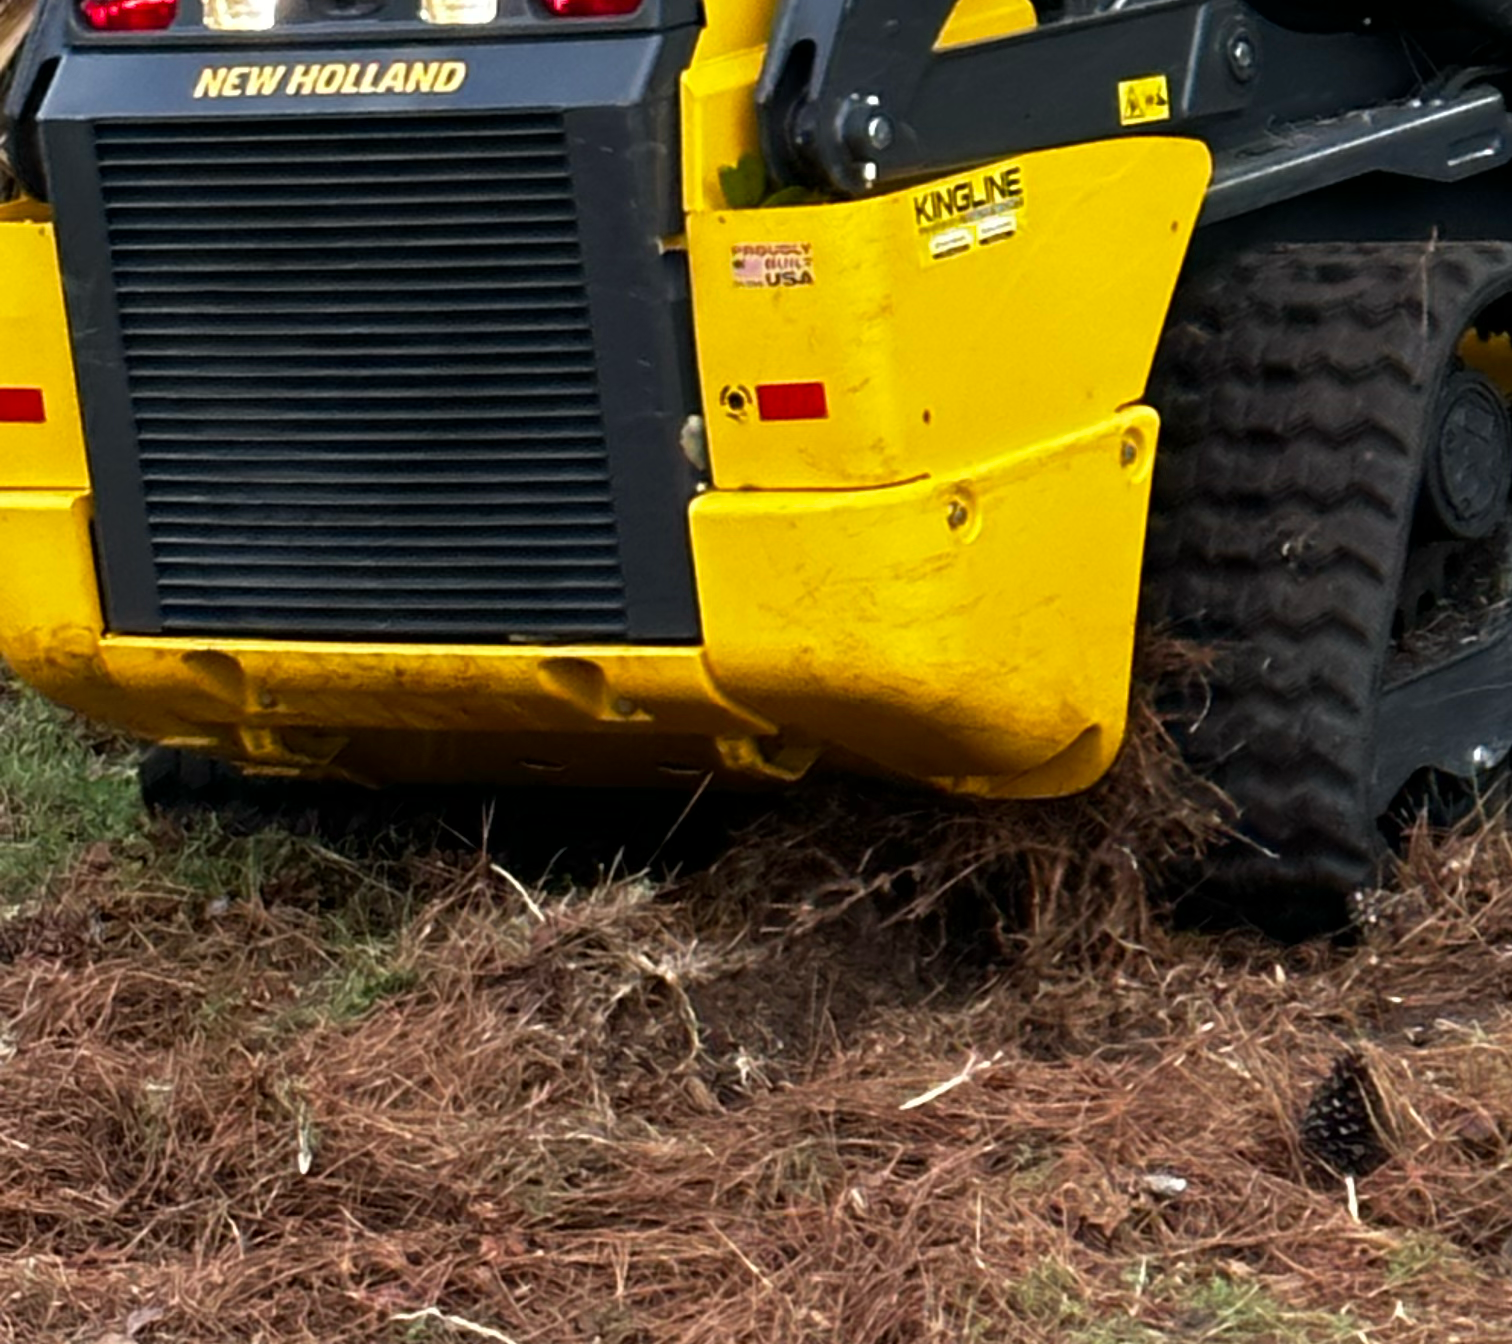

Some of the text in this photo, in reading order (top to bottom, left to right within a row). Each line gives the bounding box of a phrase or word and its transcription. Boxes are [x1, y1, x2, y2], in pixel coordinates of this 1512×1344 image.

[193, 60, 467, 99] NEW HOLLAND
[912, 166, 1024, 226] KINGLINE
[764, 270, 815, 288] USA
